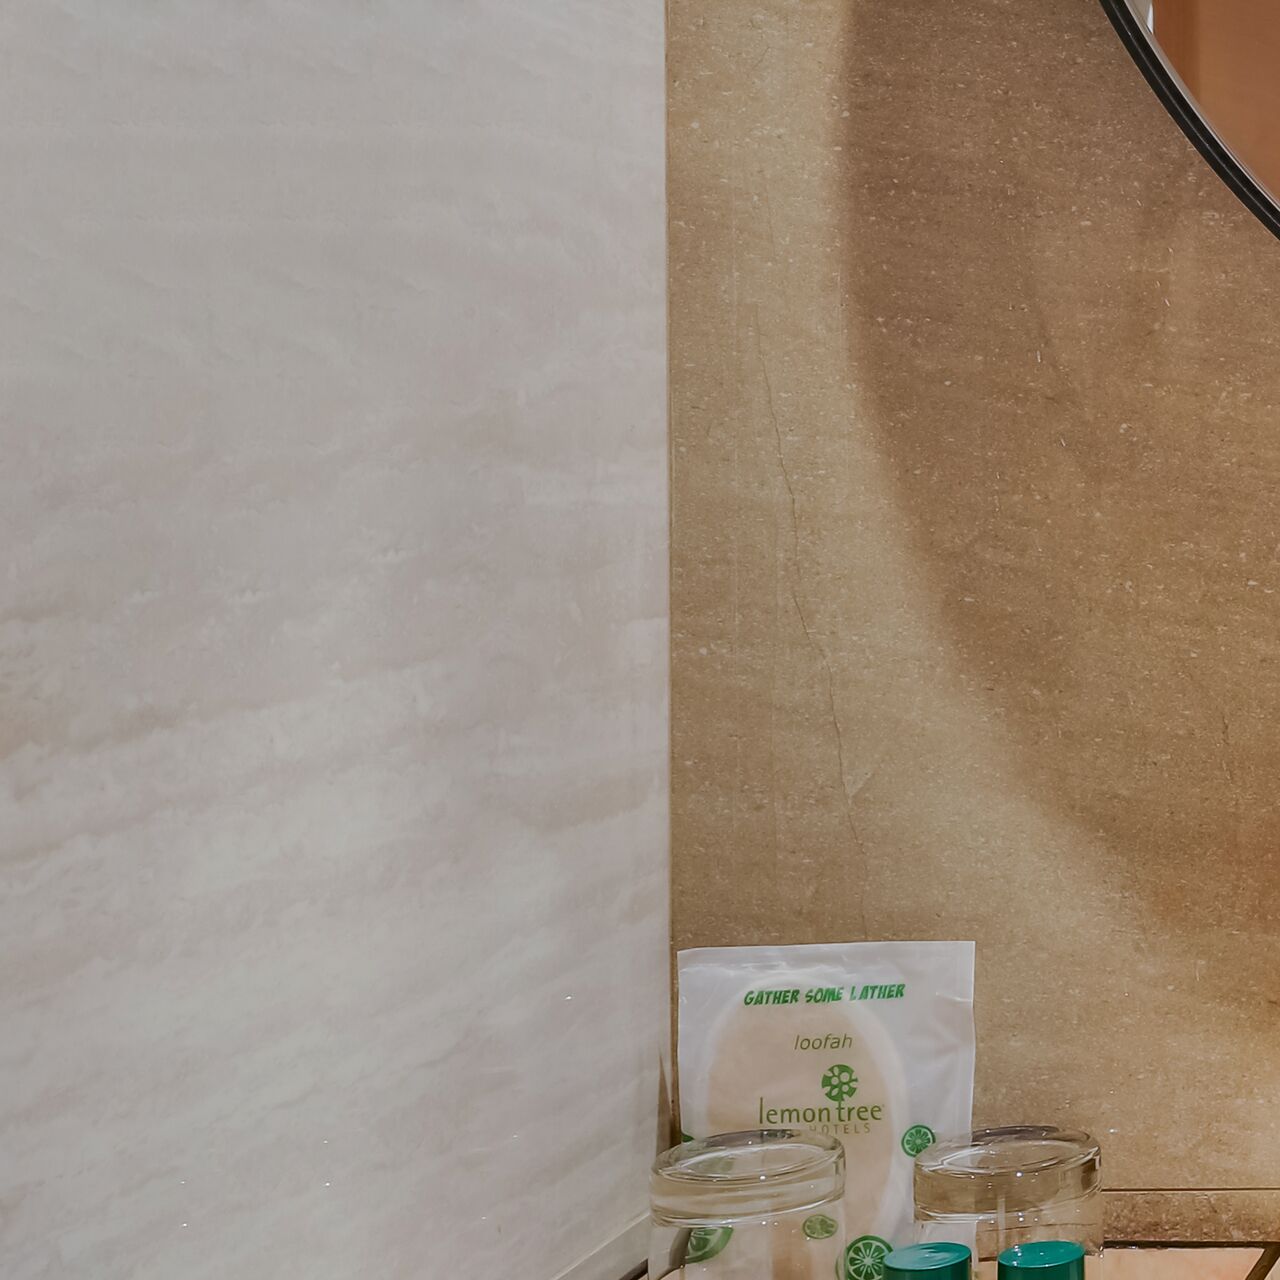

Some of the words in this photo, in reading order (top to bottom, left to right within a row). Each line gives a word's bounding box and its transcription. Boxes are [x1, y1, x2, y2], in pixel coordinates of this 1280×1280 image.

[743, 989, 801, 1006] GATHER
[805, 987, 844, 1003] SOME
[850, 984, 906, 1000] LATHER
[794, 1033, 853, 1051] loofah
[759, 1097, 831, 1125] lemon
[836, 1102, 882, 1123] tree
